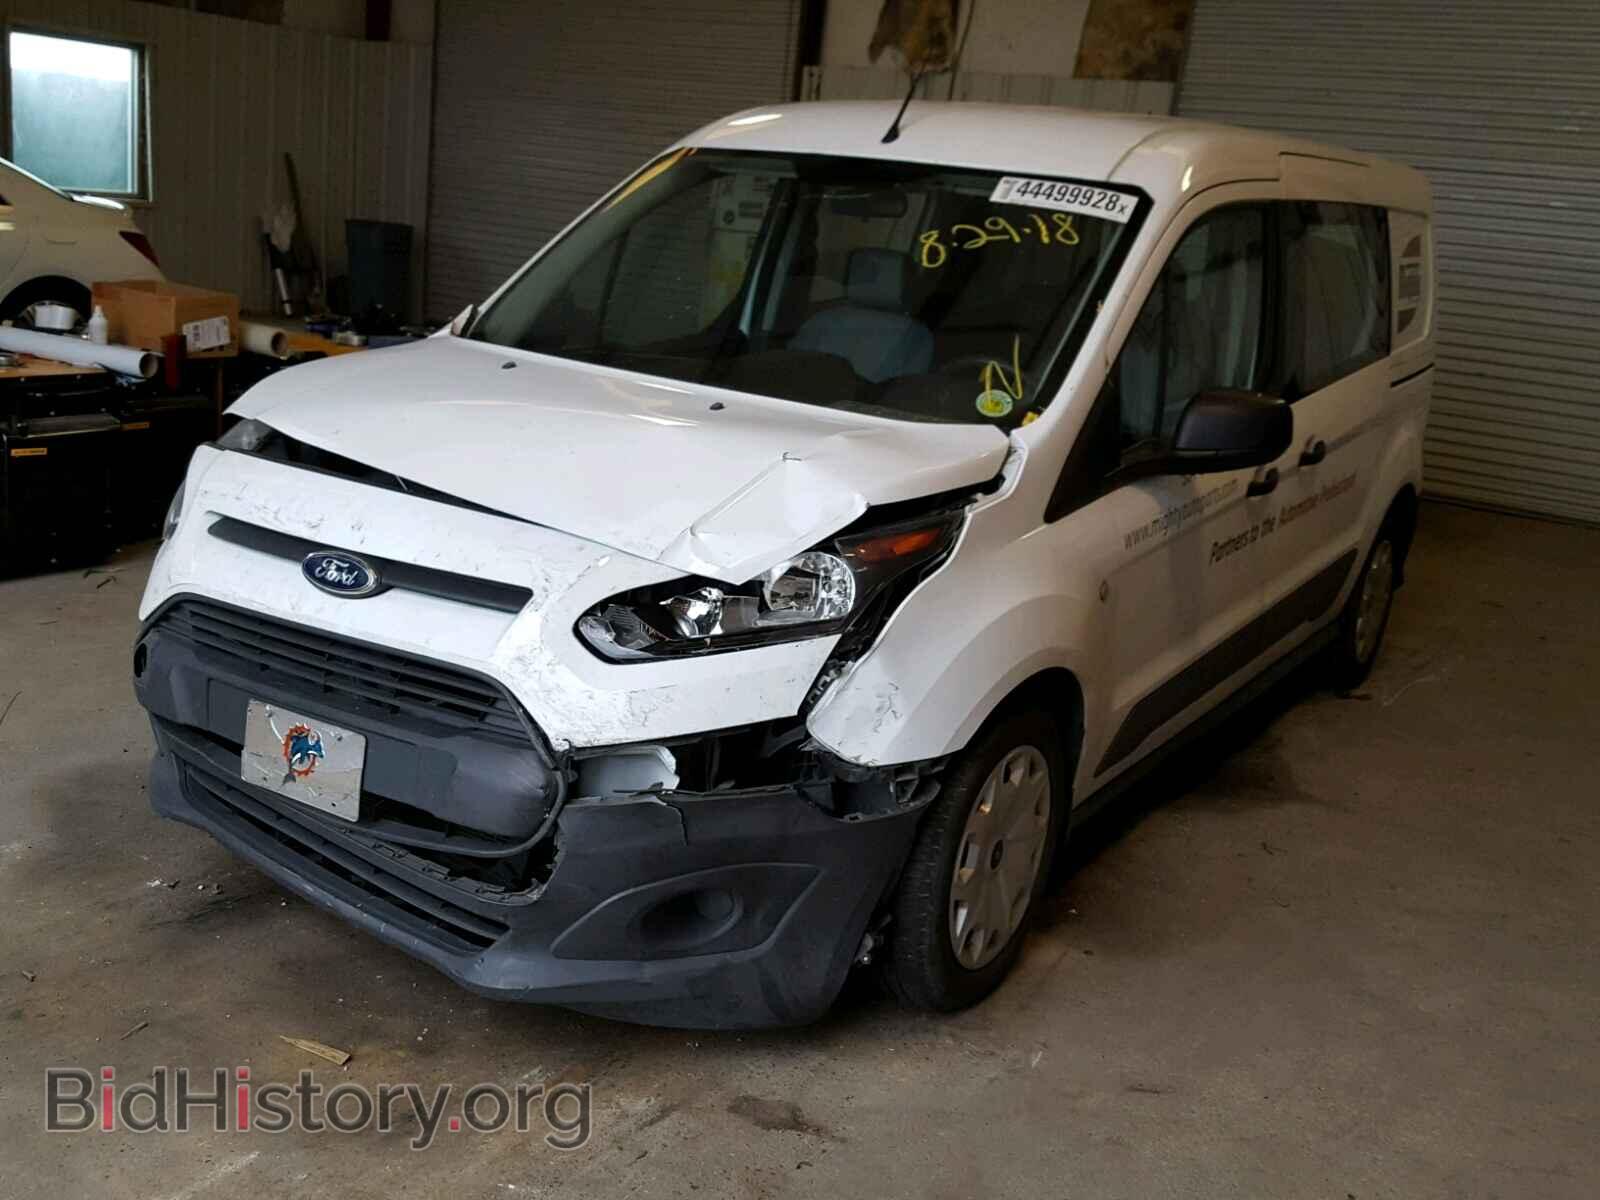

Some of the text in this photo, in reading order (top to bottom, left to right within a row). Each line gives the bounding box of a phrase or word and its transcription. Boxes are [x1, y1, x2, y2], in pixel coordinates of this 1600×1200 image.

[919, 213, 1080, 269] 8.29.18
[979, 334, 1023, 402] N
[314, 557, 359, 587] Ford
[1208, 531, 1249, 567] Partners
